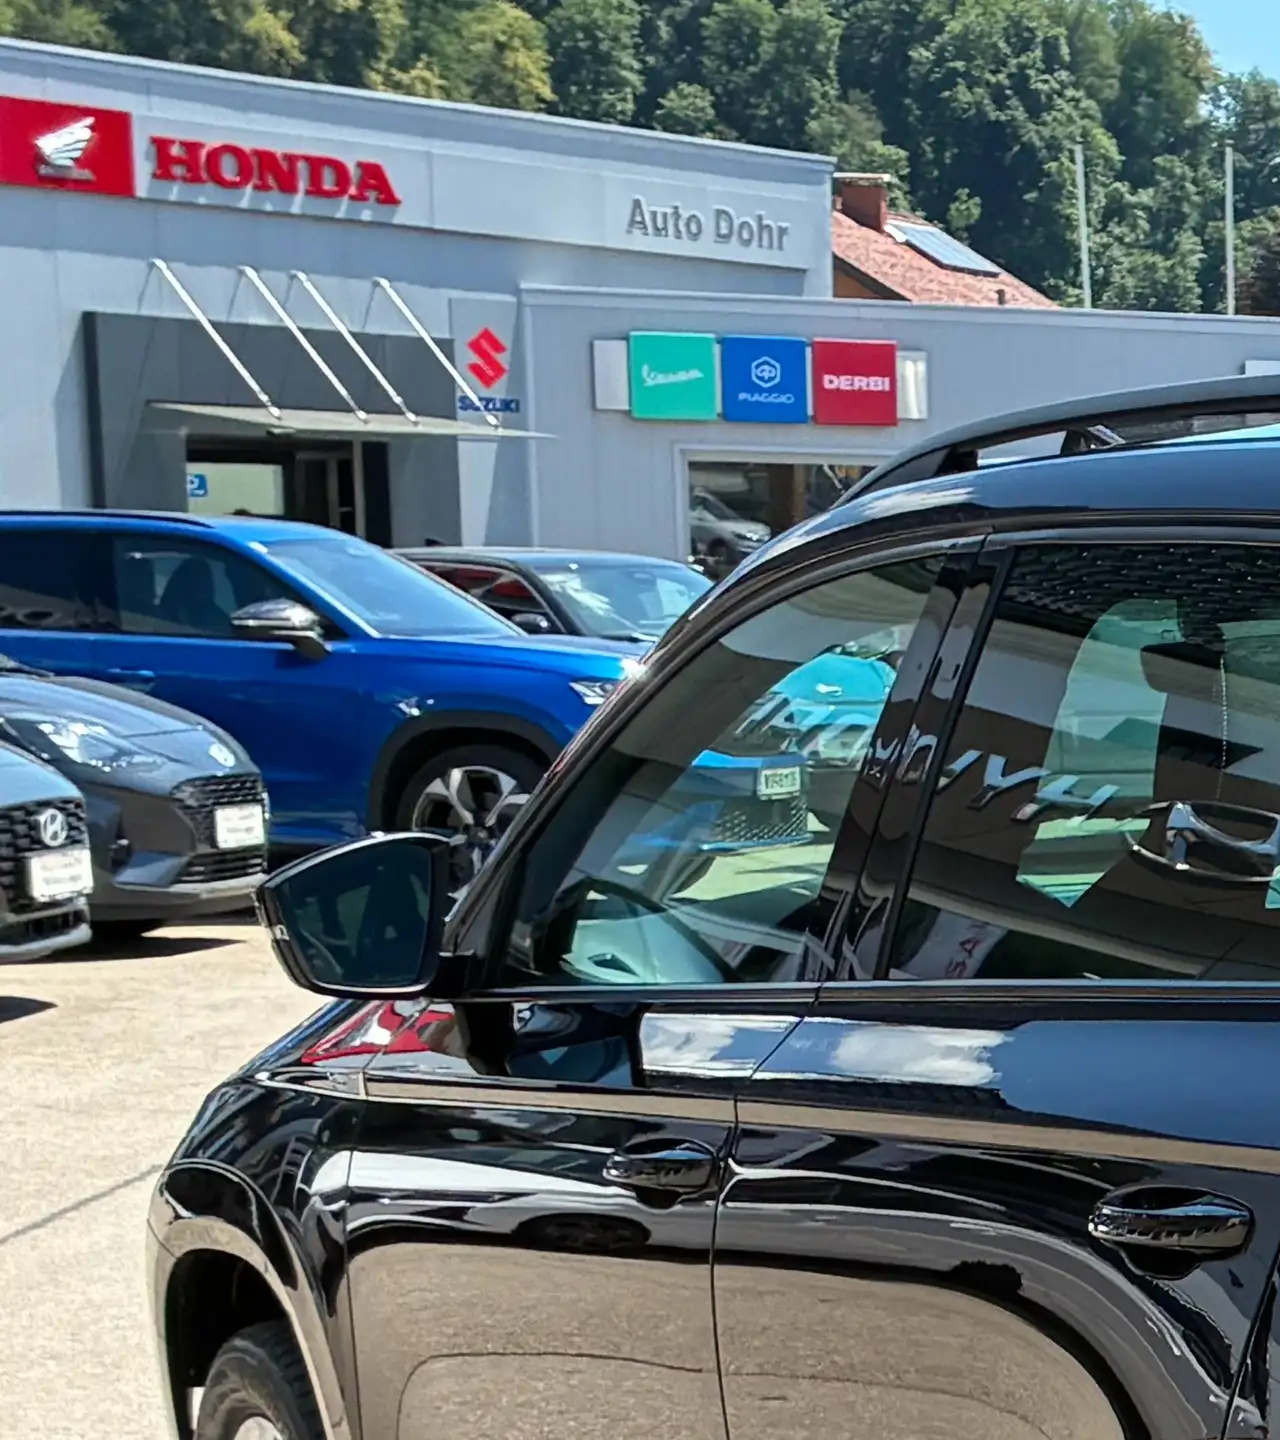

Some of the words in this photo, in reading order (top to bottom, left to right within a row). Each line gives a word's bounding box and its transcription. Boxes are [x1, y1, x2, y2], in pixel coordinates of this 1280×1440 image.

[150, 136, 401, 206] HONDA
[626, 197, 704, 241] Auto
[713, 206, 790, 251] Dohr
[738, 392, 795, 404] PIAGGIO
[823, 373, 890, 392] DERBI
